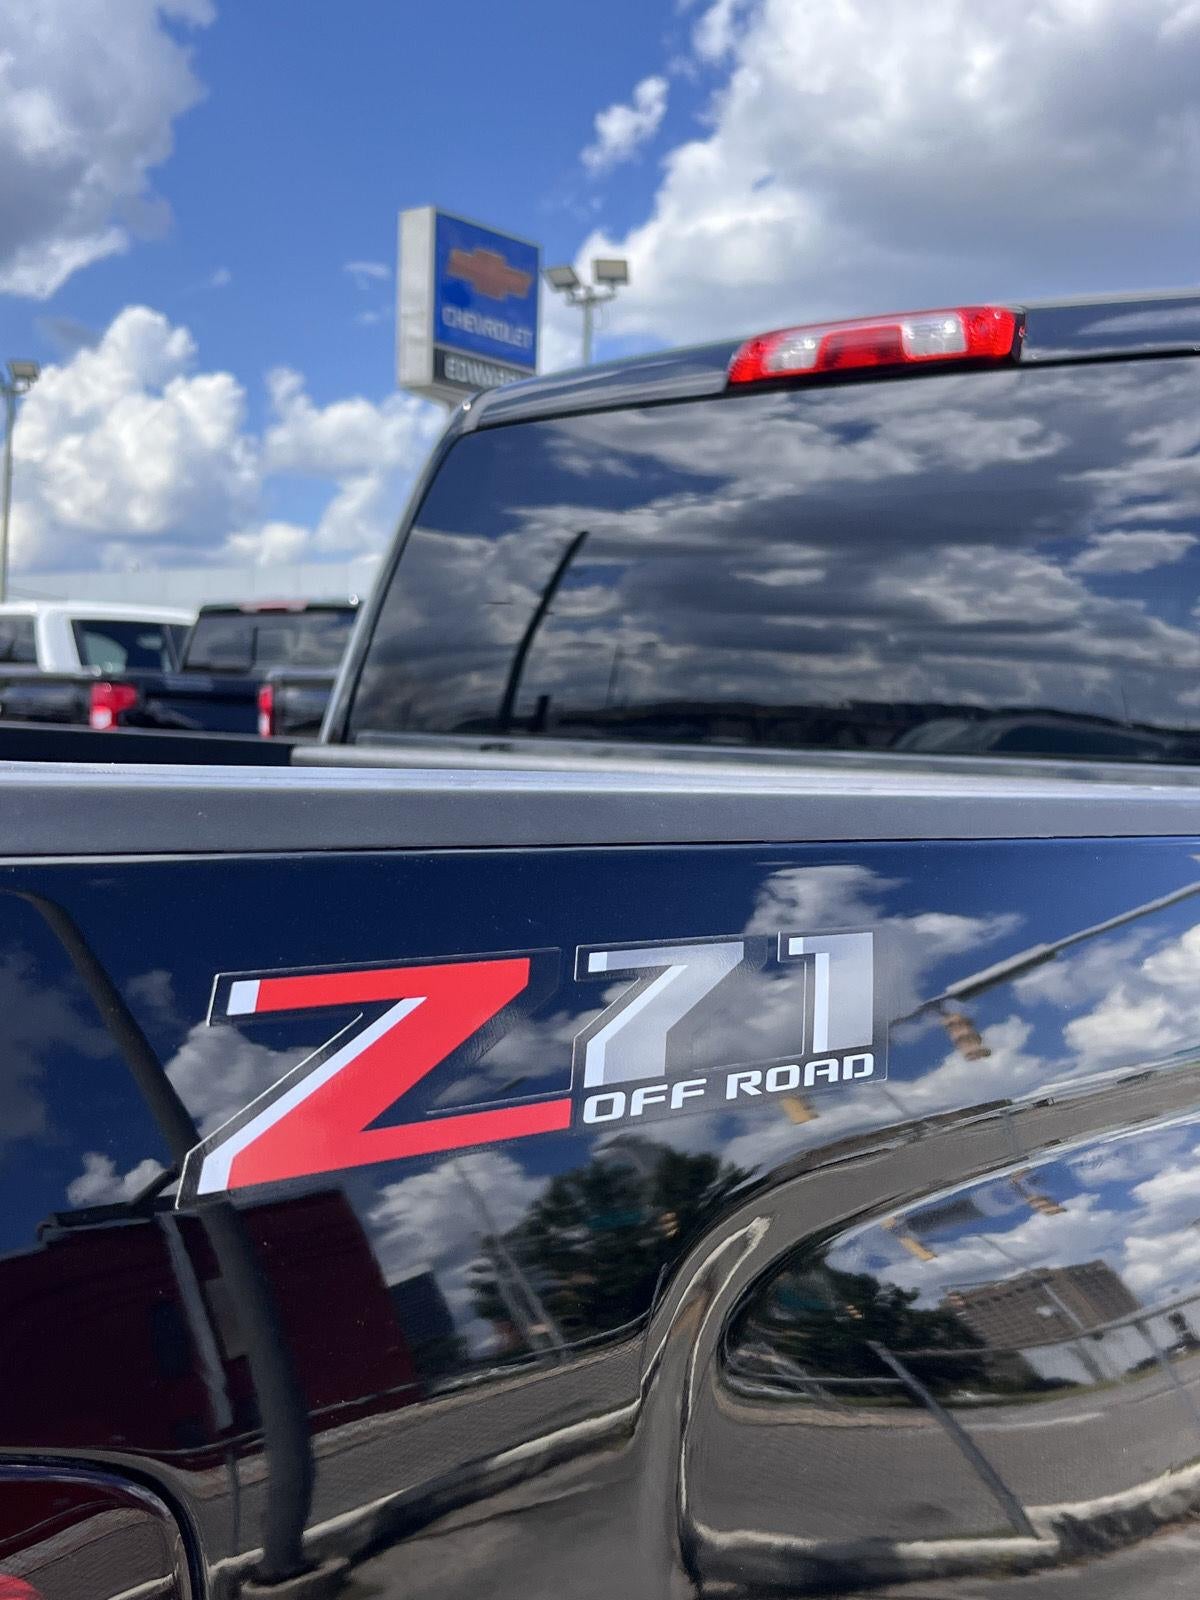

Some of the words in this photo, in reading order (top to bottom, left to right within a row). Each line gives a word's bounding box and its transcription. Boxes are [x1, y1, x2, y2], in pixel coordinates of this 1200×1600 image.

[442, 304, 533, 349] CHEVROLET
[445, 355, 528, 388] EDWAR
[197, 932, 874, 1195] Z71
[583, 1078, 707, 1124] OFF
[725, 1053, 874, 1100] ROAD
